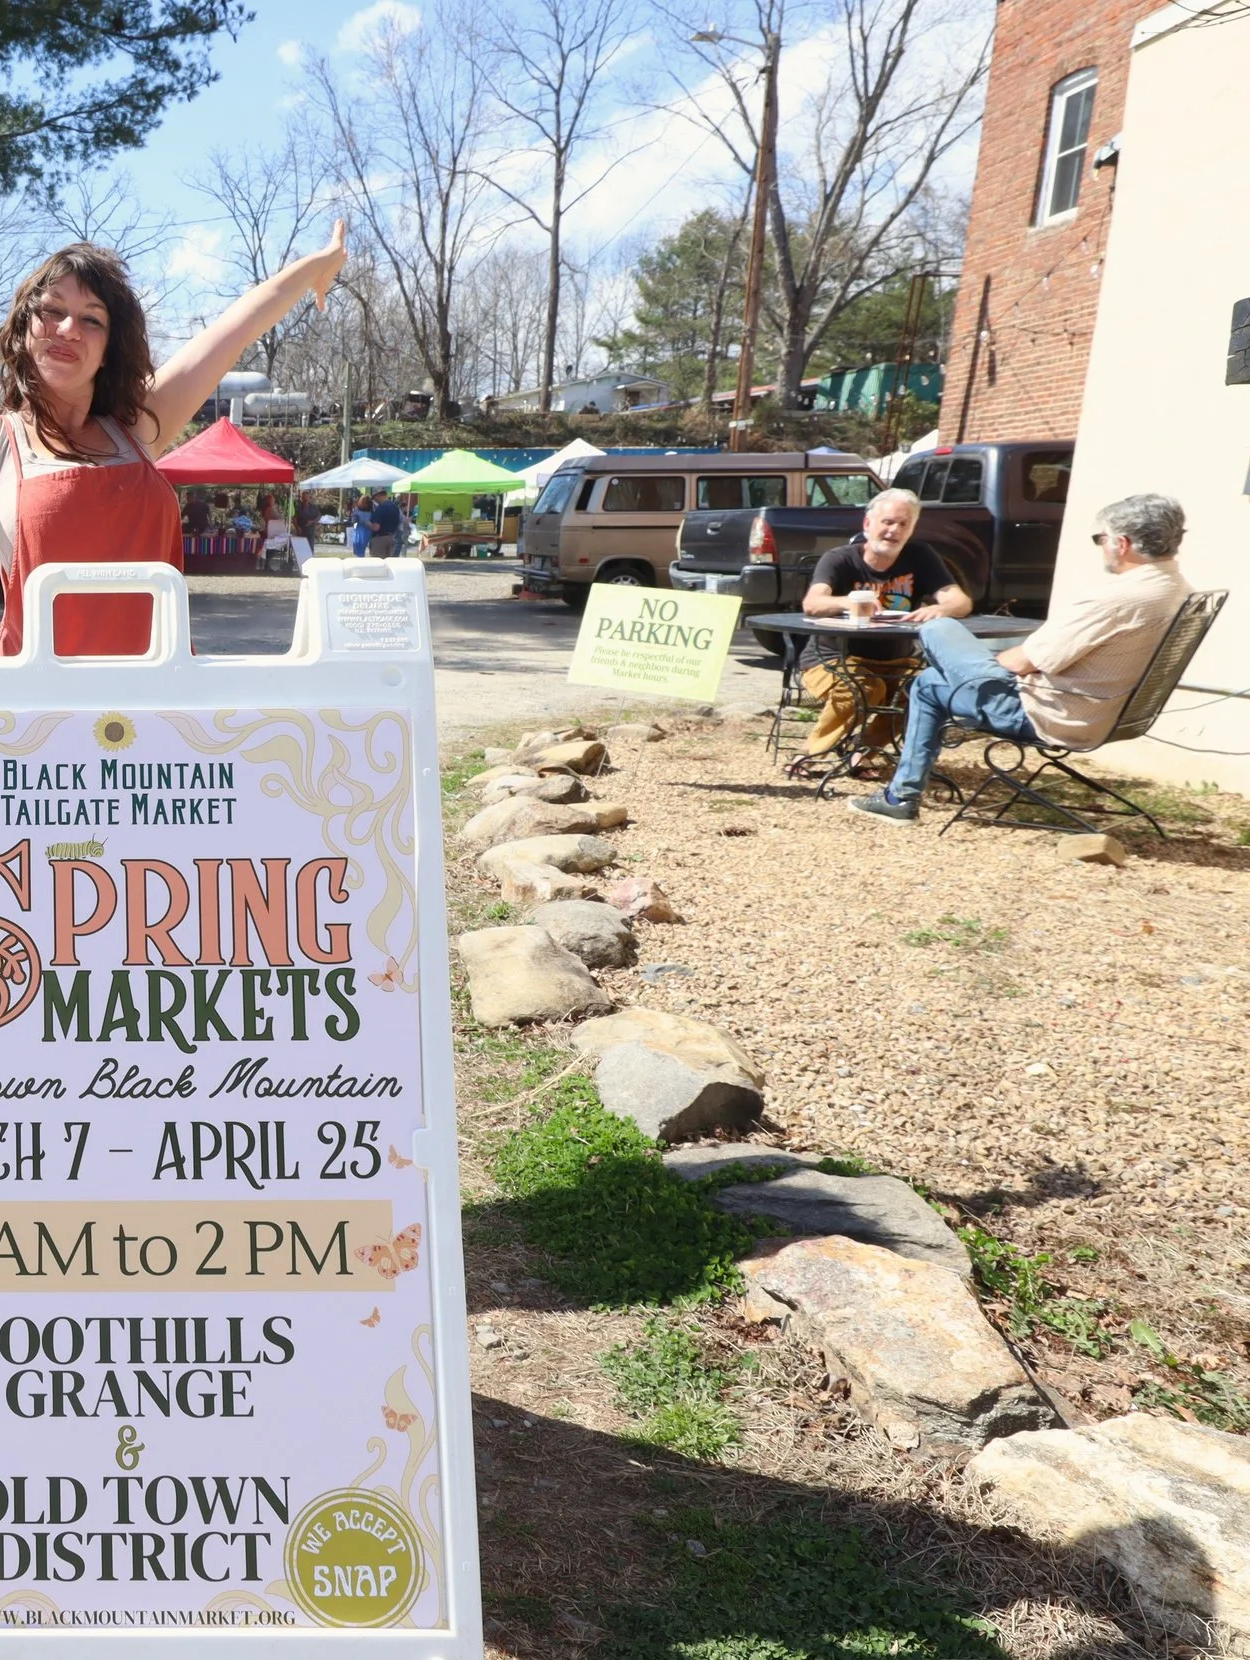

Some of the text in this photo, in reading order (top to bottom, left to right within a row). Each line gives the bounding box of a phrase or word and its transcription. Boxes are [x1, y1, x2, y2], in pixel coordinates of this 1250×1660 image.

[638, 598, 679, 622] NO
[595, 617, 714, 650] PARKING
[590, 655, 619, 666] friends
[629, 660, 669, 674] neighbors
[671, 665, 701, 679] during
[594, 646, 702, 666] Please be respectful of our
[612, 668, 641, 680] Market
[3, 759, 234, 791] BLACK MOUNTAIN
[1, 793, 236, 826] TAILGATE MARKET
[42, 968, 361, 1054] MARKETS
[79, 1057, 197, 1099] Black
[209, 1057, 403, 1099] Mountain
[64, 1121, 91, 1181] 7
[152, 1120, 299, 1190] APRIL
[317, 1120, 382, 1180] 25
[113, 1224, 178, 1276] to
[195, 1221, 227, 1276] 2
[245, 1220, 354, 1276] PM
[6, 1369, 254, 1418] GRANGE
[115, 1424, 145, 1471] &
[103, 1475, 291, 1525] TOWN
[301, 1509, 407, 1555] WE ACCEPT
[314, 1565, 397, 1597] SNAP
